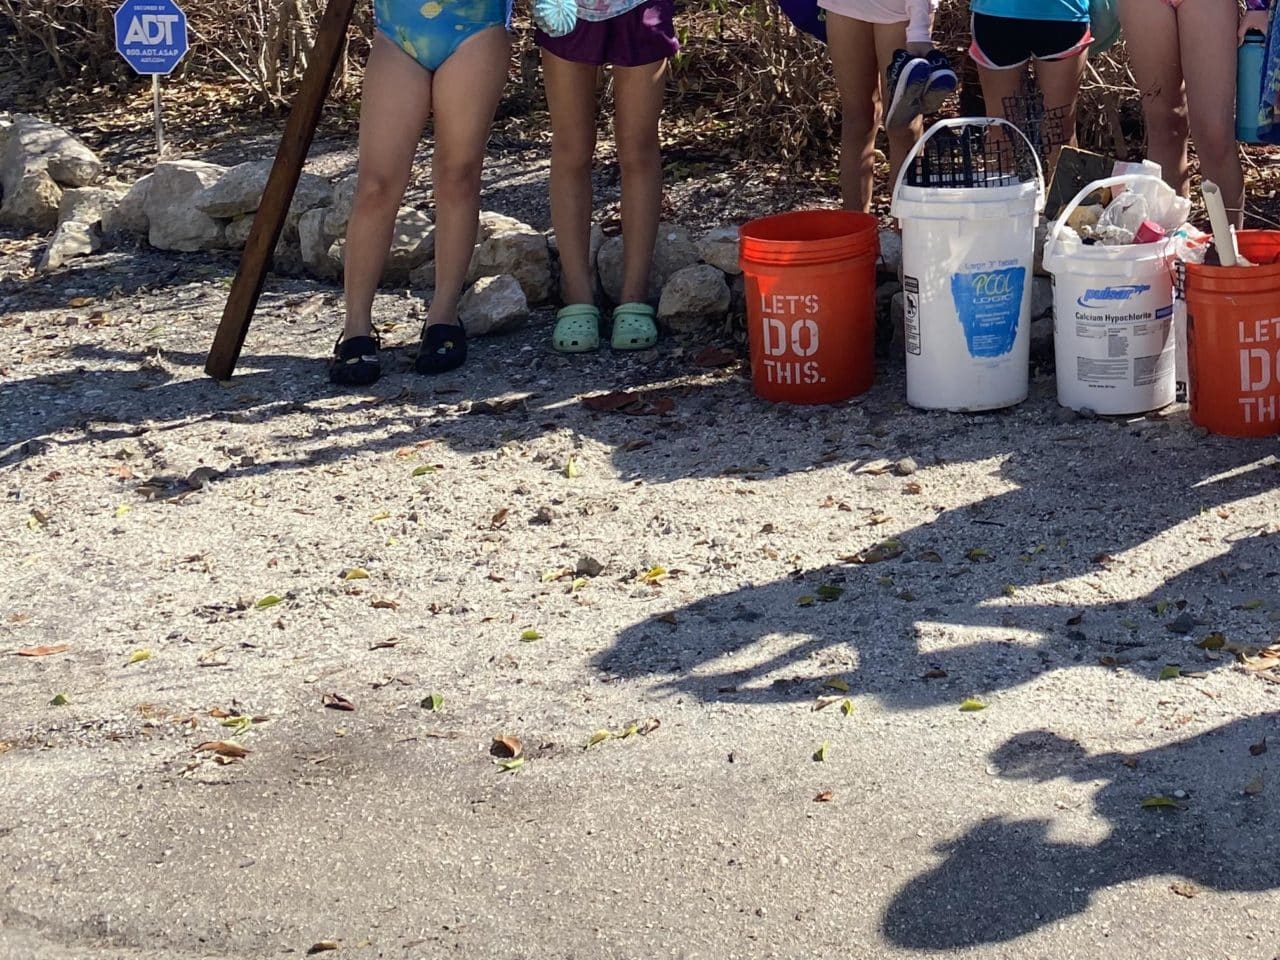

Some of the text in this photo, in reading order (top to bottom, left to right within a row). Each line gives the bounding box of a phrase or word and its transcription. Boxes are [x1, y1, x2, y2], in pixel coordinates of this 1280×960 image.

[123, 15, 178, 45] ADT
[761, 293, 819, 315] LET'S
[1075, 311, 1104, 321] Calcium
[1105, 311, 1152, 323] Hypochlorite
[763, 318, 819, 356] DO
[763, 359, 826, 384] THIS.
